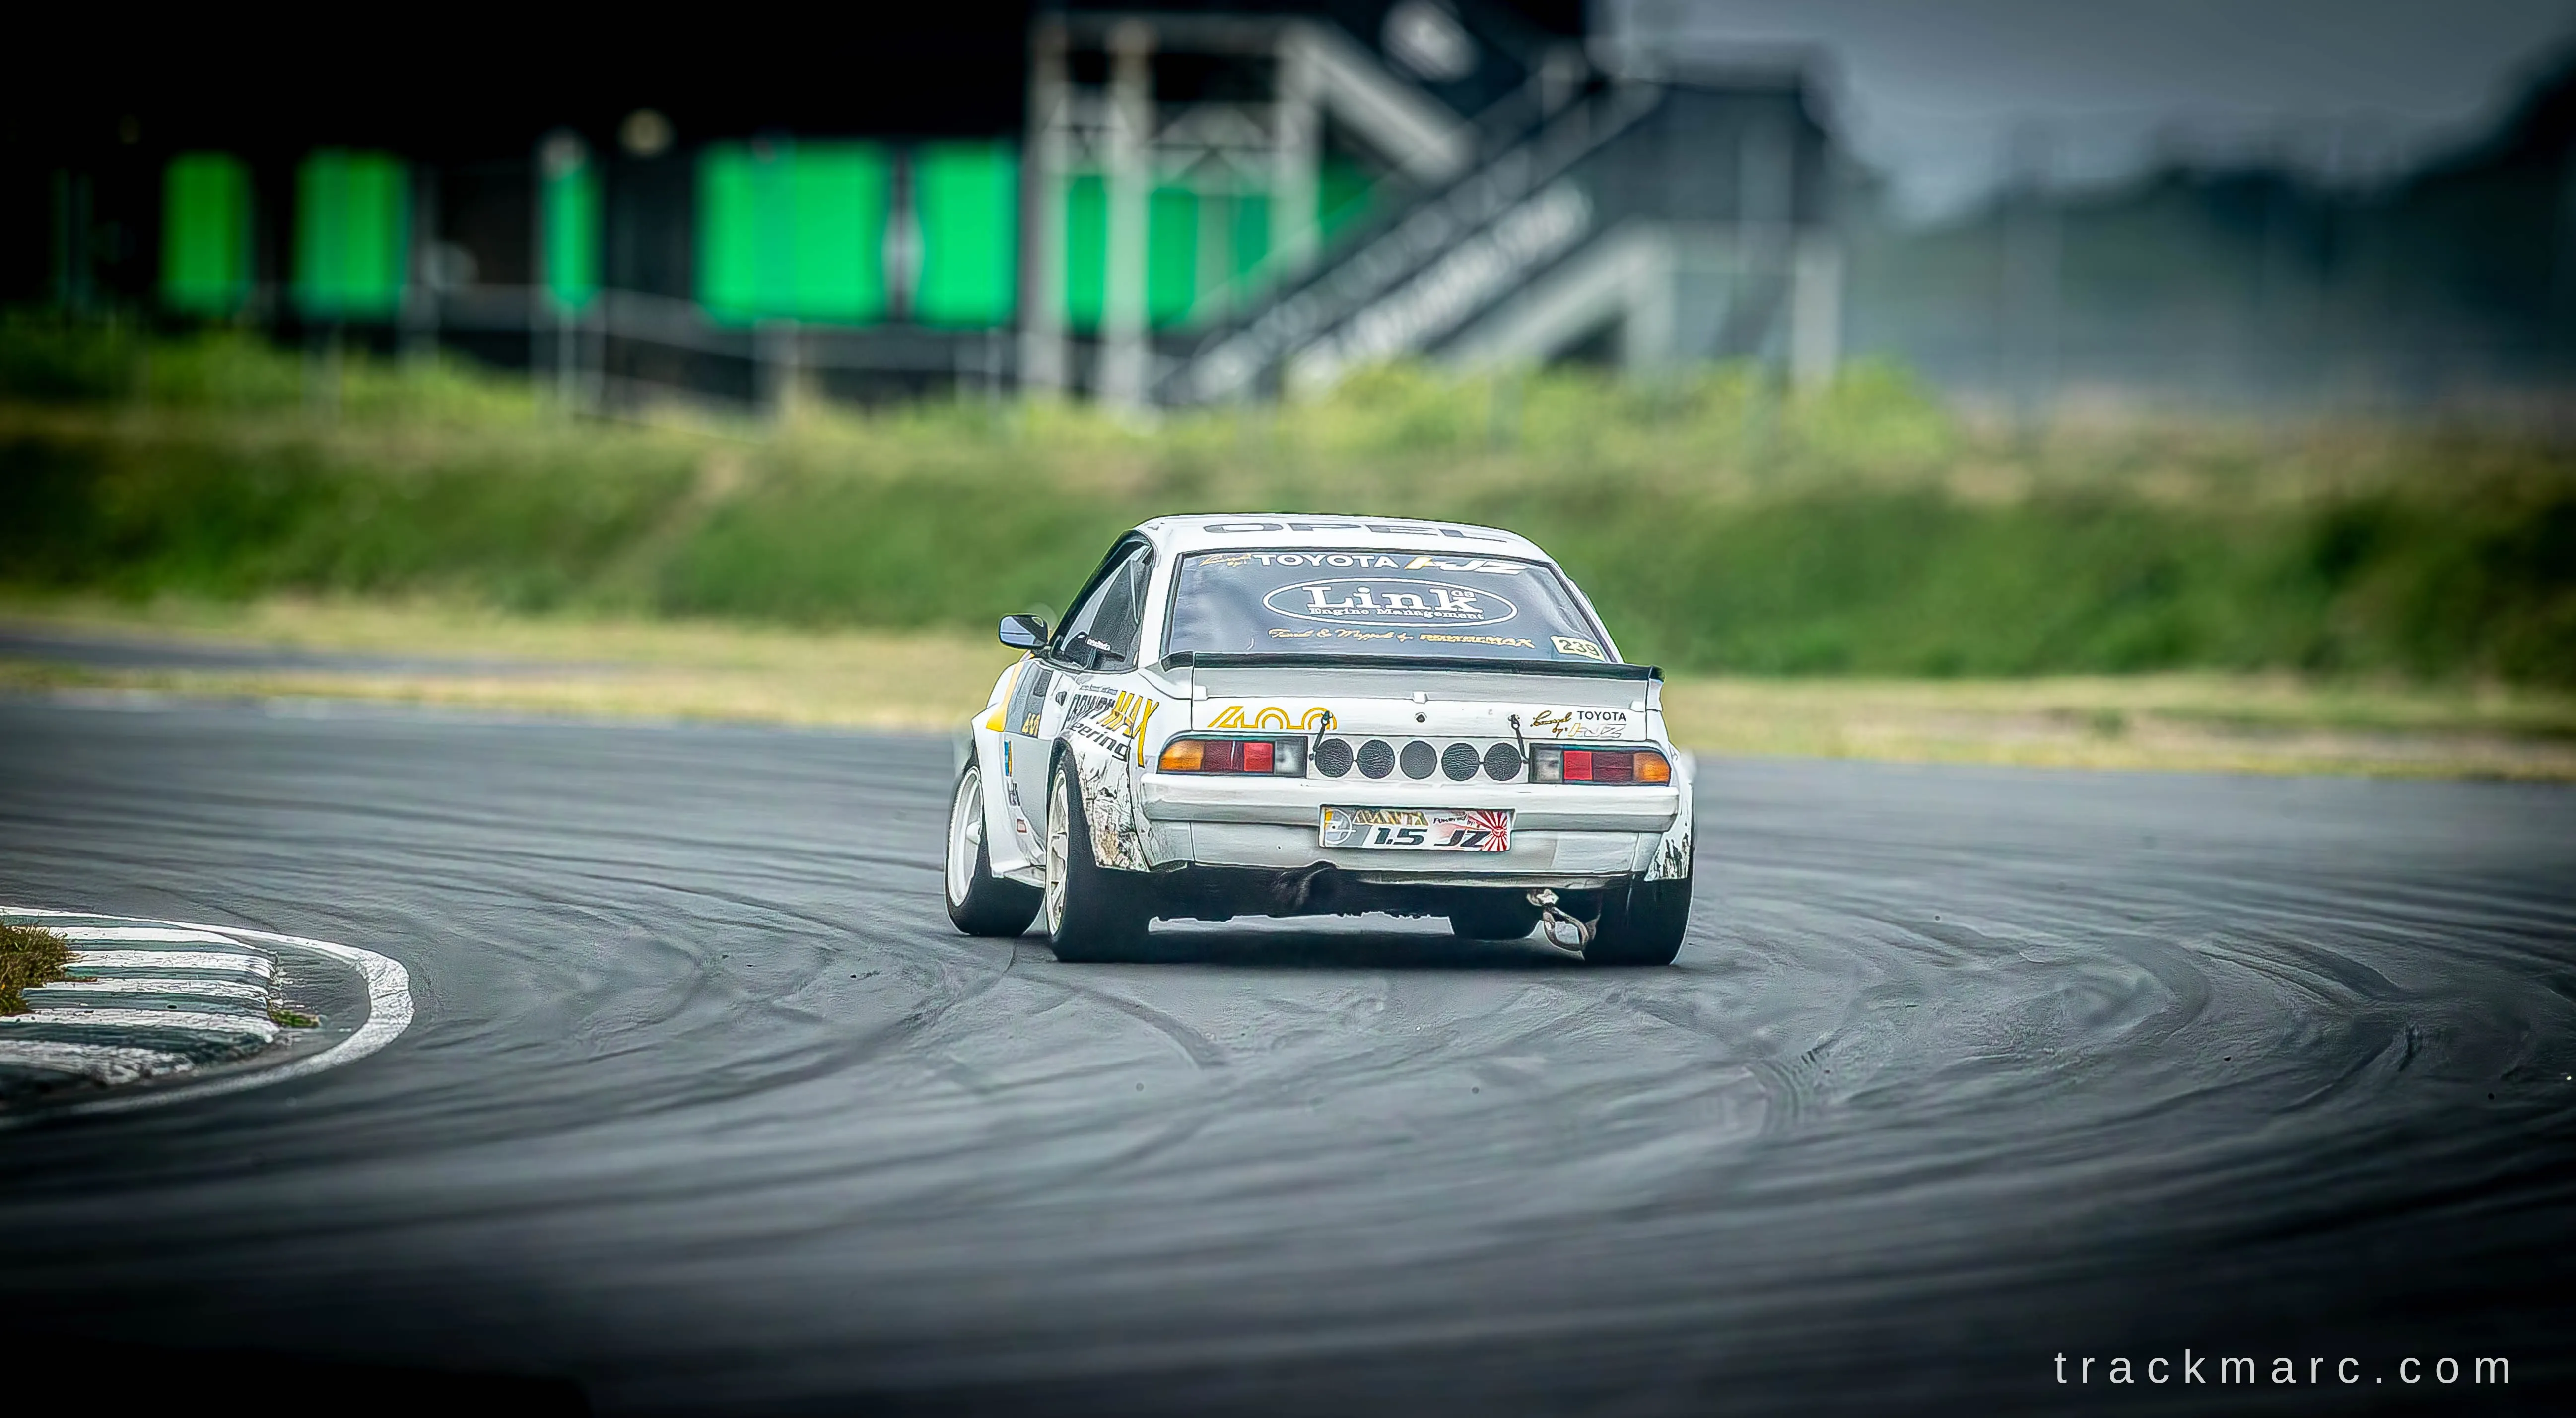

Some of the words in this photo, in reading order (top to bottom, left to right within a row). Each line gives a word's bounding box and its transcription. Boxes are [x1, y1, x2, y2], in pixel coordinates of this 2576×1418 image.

[1252, 554, 1399, 569] TOYOTA
[1302, 586, 1484, 614] Link
[1308, 608, 1370, 616] Engine
[1376, 608, 1485, 620] Management
[1559, 639, 1590, 656] 239
[1207, 706, 1337, 730] 400
[1577, 711, 1627, 721] TOYOTA
[1434, 830, 1491, 848] JZ
